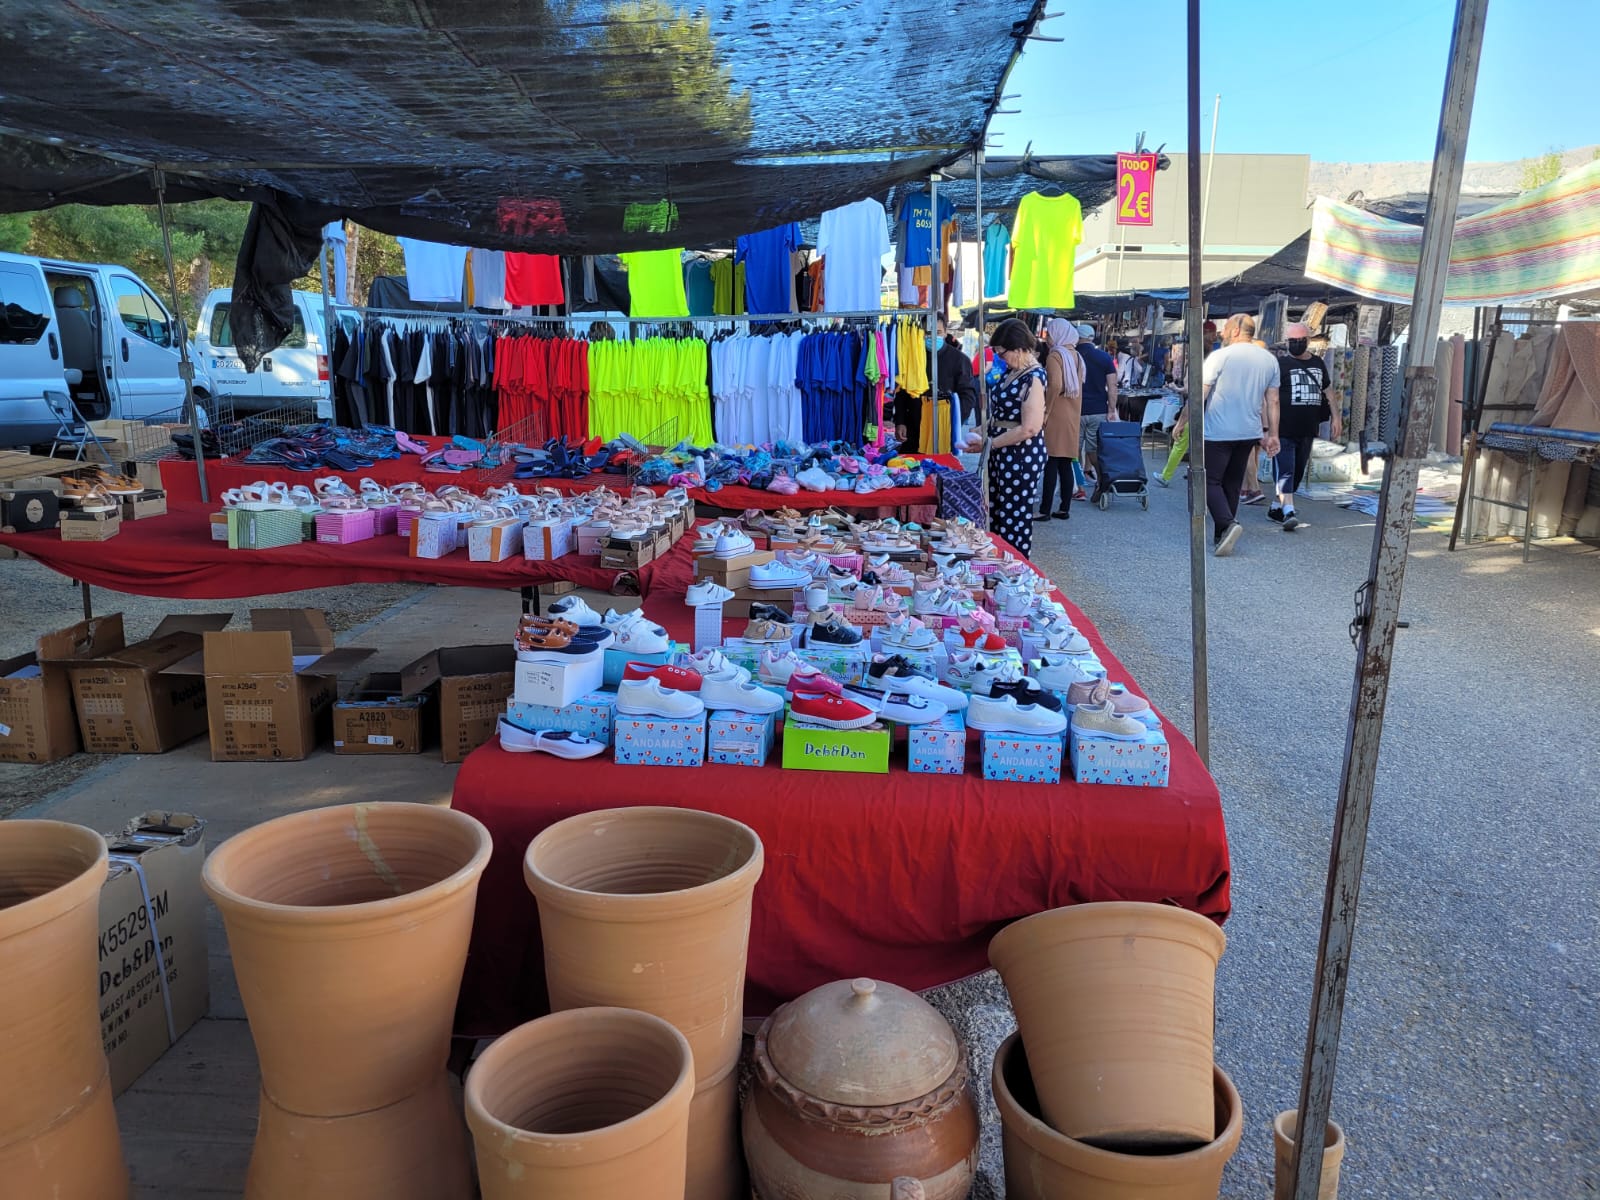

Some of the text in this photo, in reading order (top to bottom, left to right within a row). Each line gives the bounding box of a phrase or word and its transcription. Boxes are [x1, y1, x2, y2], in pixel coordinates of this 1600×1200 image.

[1121, 159, 1150, 171] TODO
[1120, 173, 1150, 218] 2€
[529, 715, 588, 731] ANDAMAS
[632, 737, 685, 750] ANDAMAS
[805, 742, 866, 759] Deb&Dan
[1000, 756, 1046, 768] ANDAMAS
[1097, 758, 1151, 769] ANDAMAS
